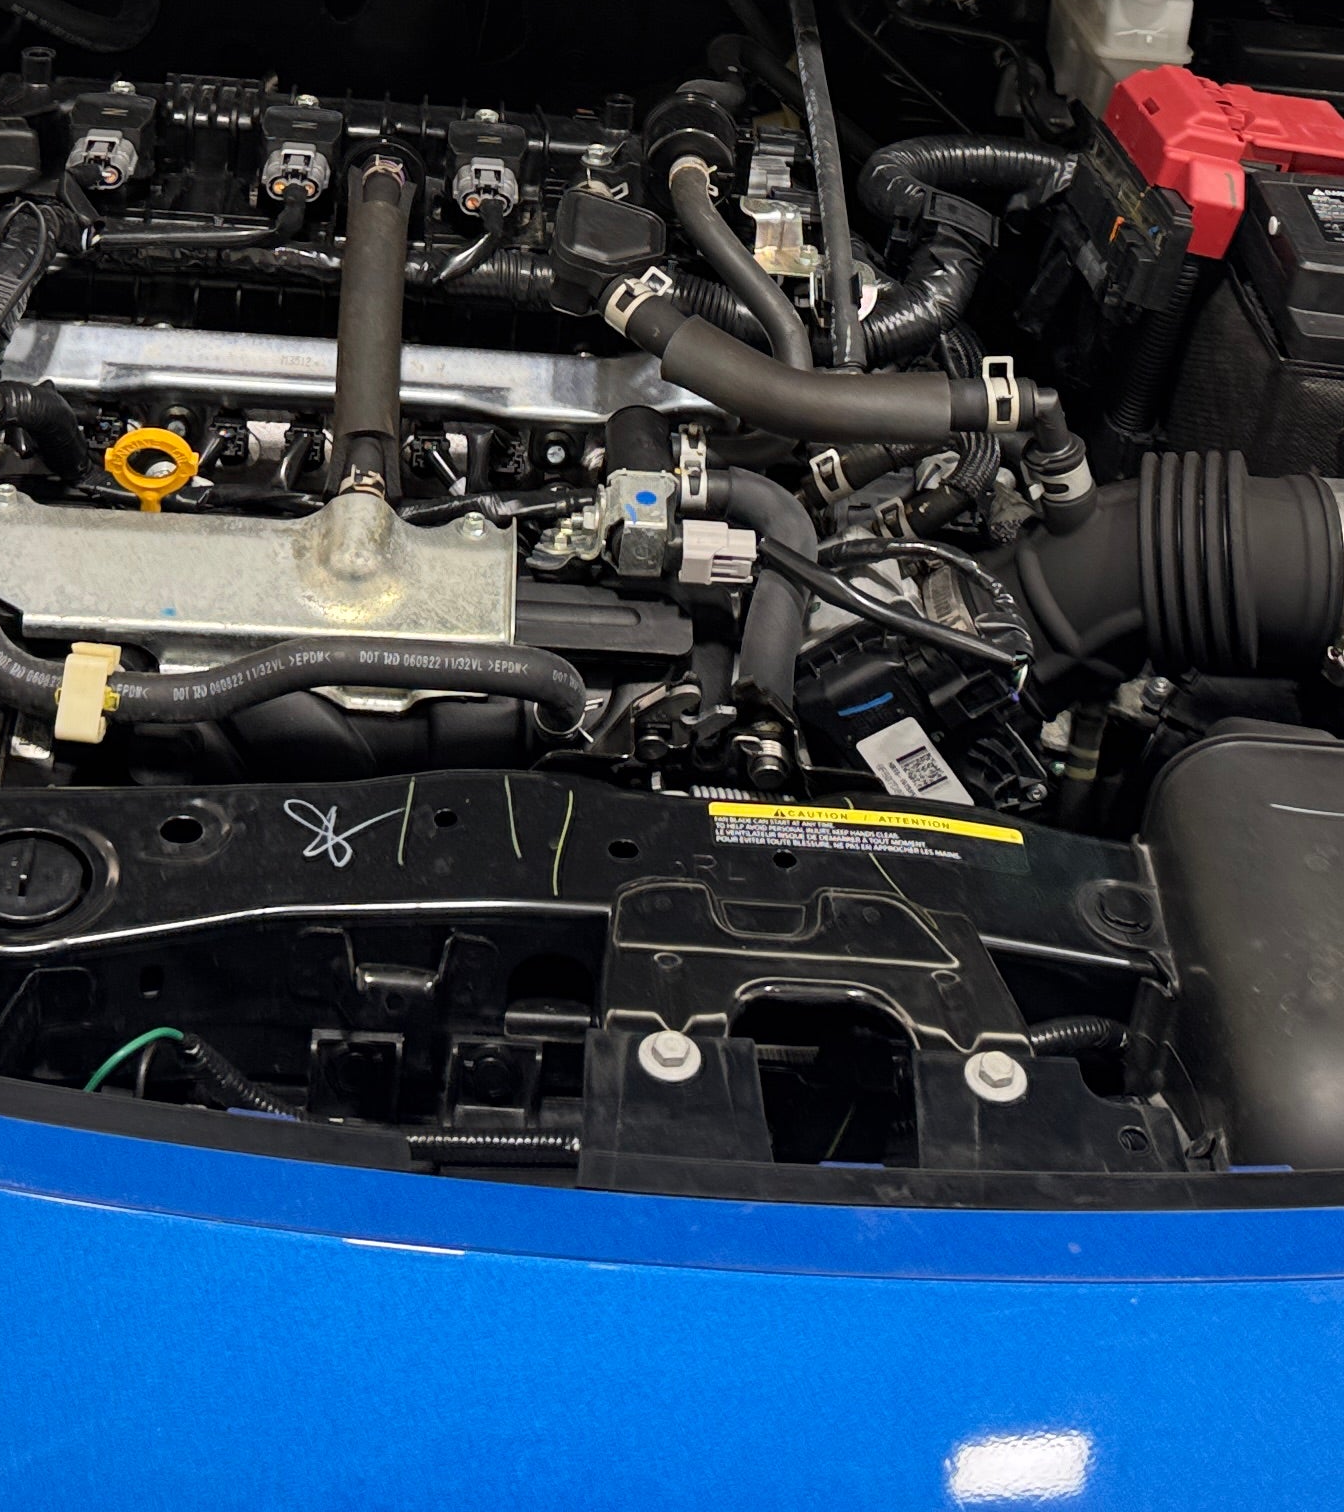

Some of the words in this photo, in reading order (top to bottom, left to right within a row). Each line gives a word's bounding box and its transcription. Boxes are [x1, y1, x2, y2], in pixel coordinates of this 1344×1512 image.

[359, 650, 380, 663] DOT
[787, 809, 848, 820] CAUTION
[878, 815, 951, 829] ATTENTION
[726, 829, 776, 838] VENTILATEUR
[778, 832, 805, 840] RISQUE
[869, 837, 889, 845] TOUT
[769, 825, 803, 833] PERSONAL
[850, 829, 875, 838] HANDS
[716, 835, 738, 843] POUR
[767, 838, 791, 846] TOUTE
[833, 841, 844, 849] NE
[845, 842, 860, 850] PAS
[861, 843, 872, 851] EN
[873, 844, 919, 854] APPROCHER
[920, 847, 934, 856] LES
